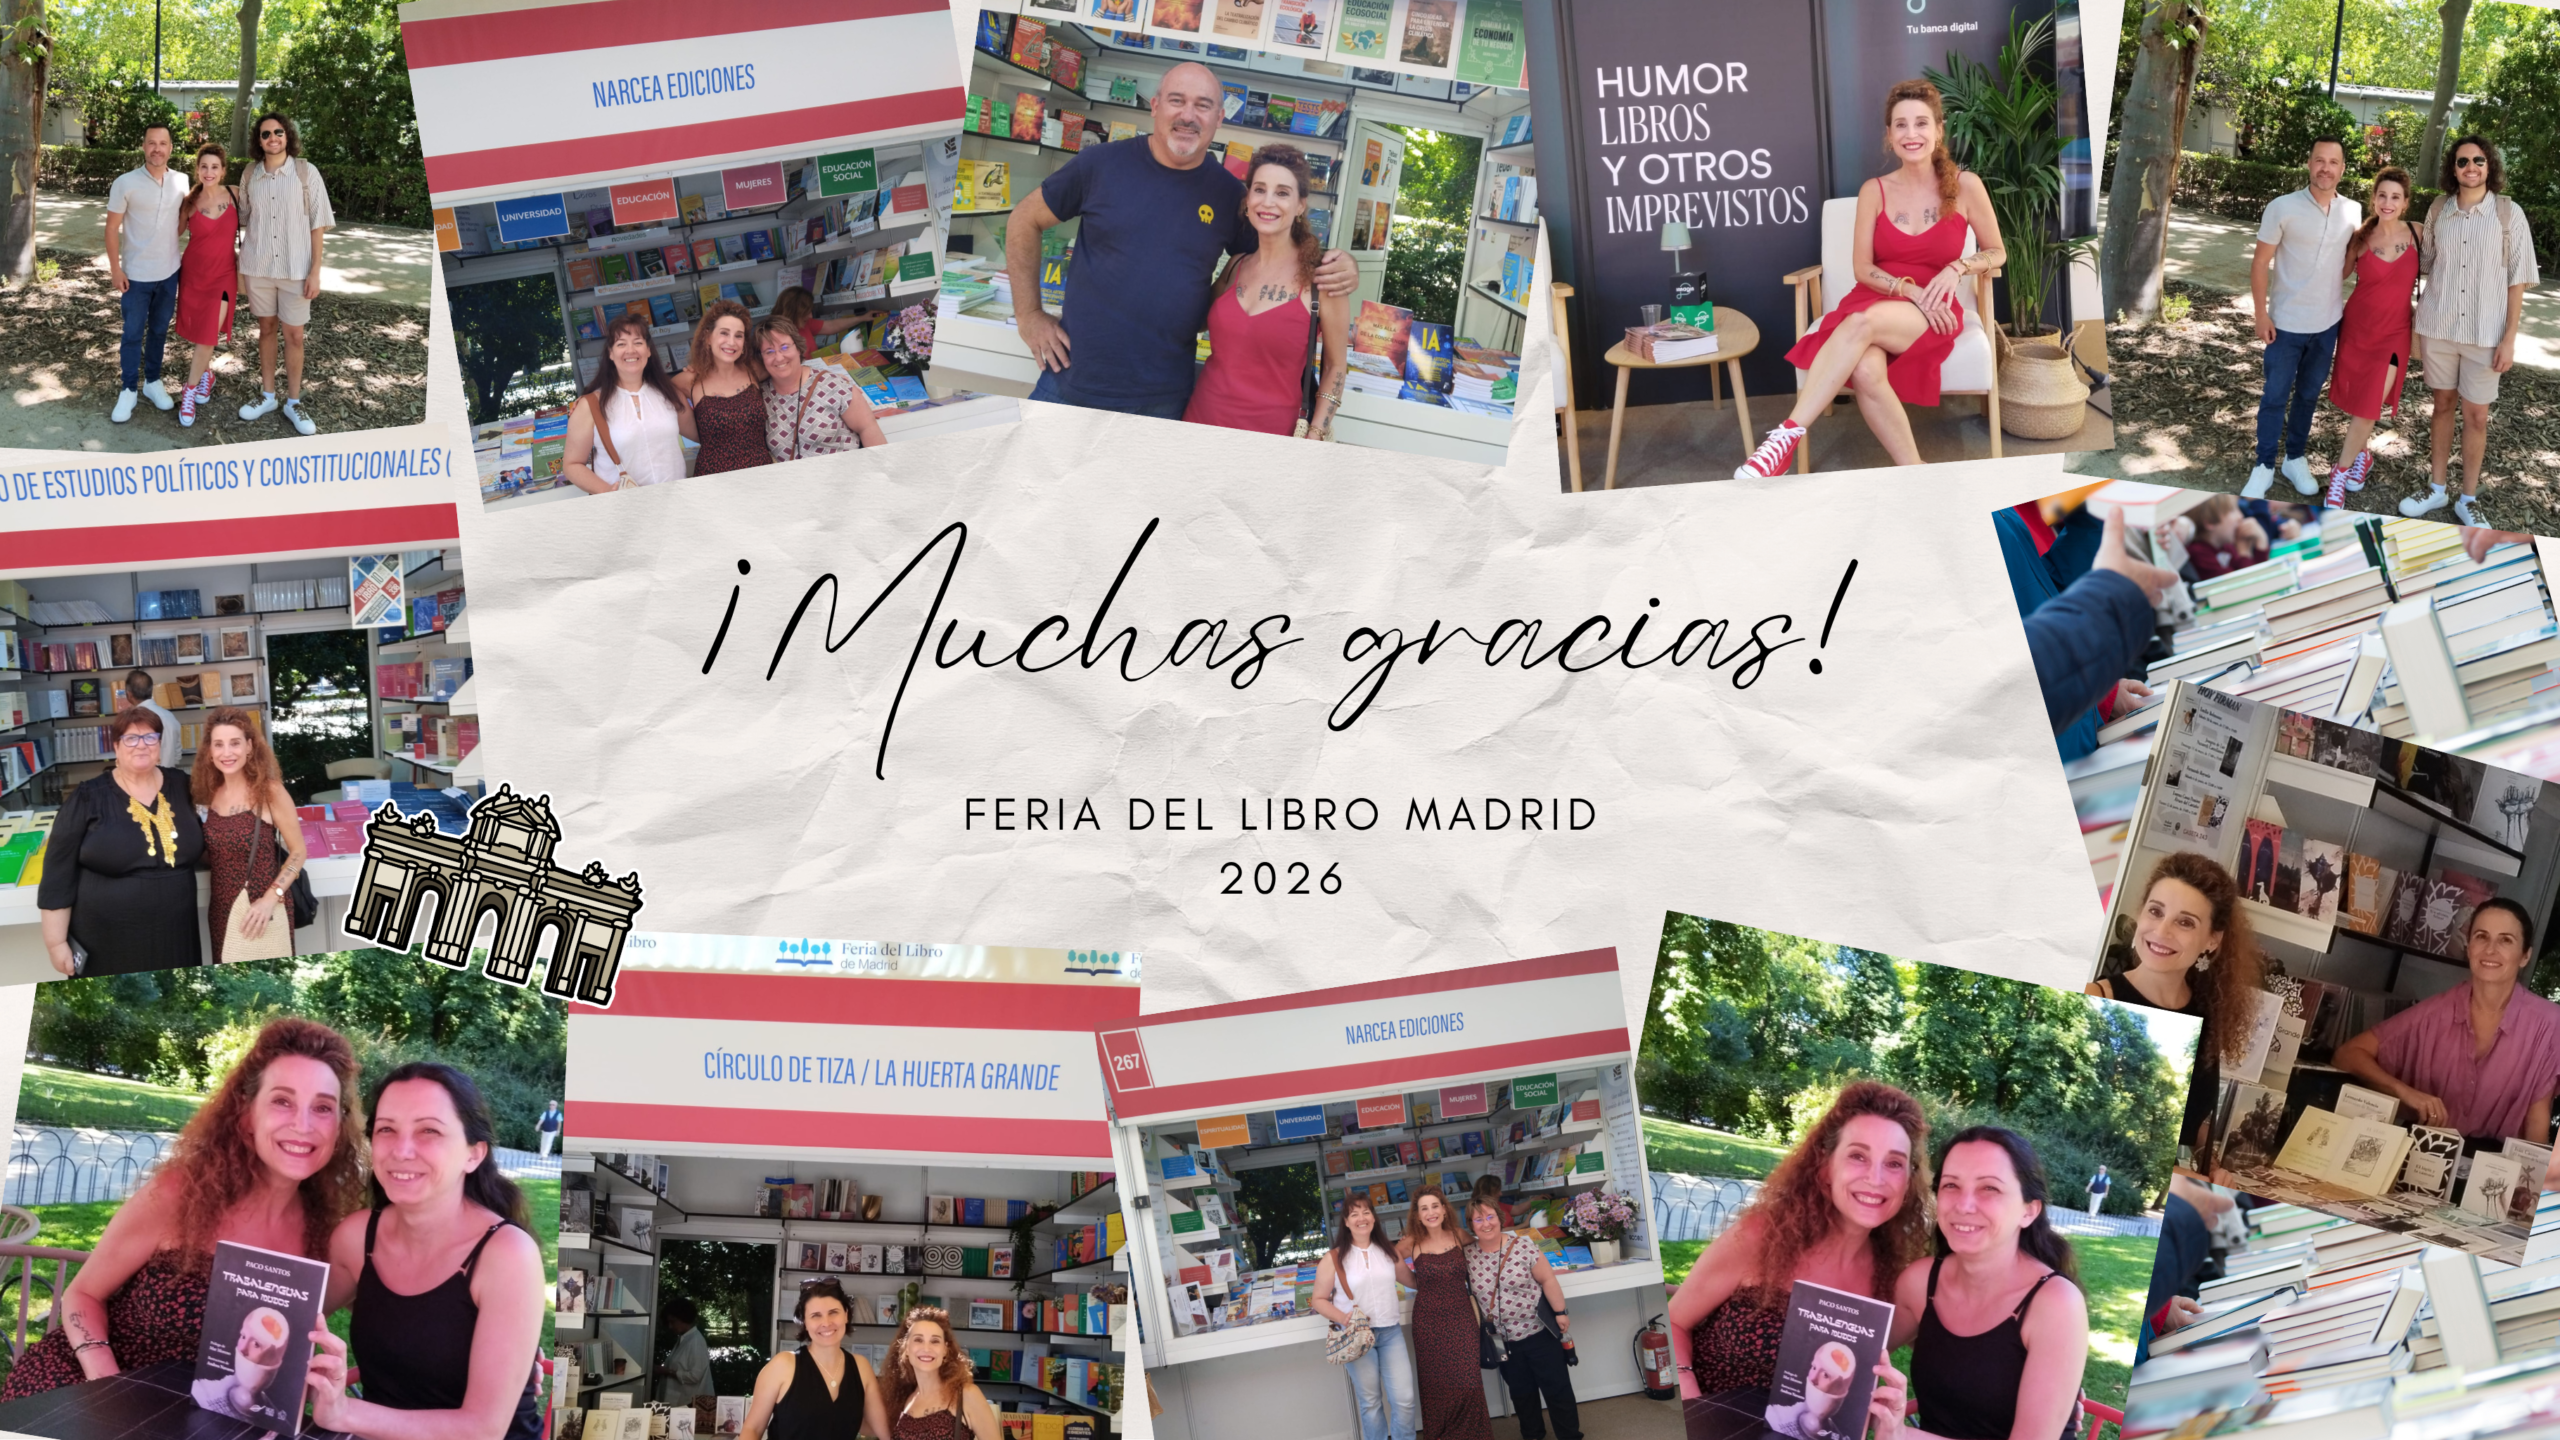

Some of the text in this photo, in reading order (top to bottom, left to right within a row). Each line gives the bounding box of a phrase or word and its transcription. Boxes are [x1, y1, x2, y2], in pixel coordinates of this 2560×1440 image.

[1347, 0, 1390, 11] EDUCACIÓN
[1345, 6, 1388, 20] ECOSOCIAL
[1410, 17, 1450, 28] PARA ENTENDER
[1503, 22, 1510, 30] LA
[1906, 21, 1978, 34] Tu banca digital
[1474, 28, 1514, 42] ECONOMÍA
[1489, 41, 1513, 50] NEGOCIO
[592, 63, 756, 108] NARCEA EDICIONES
[1596, 61, 1749, 99] HUMOR
[1598, 102, 1711, 145] LIBROS
[822, 159, 872, 174] EDUCACIÓN
[1601, 147, 1772, 186] Y OTROS
[735, 177, 772, 190] MUJERES
[833, 171, 863, 182] SOCIAL
[616, 190, 670, 206] EDUCACIÓN
[501, 207, 562, 223] UNIVERSIDAD
[1605, 185, 1809, 234] IMPREVISTOS
[611, 231, 647, 243] novedades
[1043, 262, 1062, 285] IA
[631, 281, 645, 291] hoy
[658, 326, 671, 336] hoy
[1421, 327, 1441, 351] IA
[13, 472, 41, 501] DE
[43, 466, 138, 499] ESTUDIOS
[142, 457, 239, 494] POLÍTICOS
[242, 459, 255, 488] Y
[260, 447, 442, 487] CONSTITUCIONALES
[359, 583, 378, 604] LIBRO
[2197, 685, 2243, 712] HOY FIRMAN
[626, 936, 657, 950] ibro
[841, 942, 943, 958] Feria del Libro
[840, 957, 898, 971] de Madrid
[1131, 953, 1142, 964] F
[1345, 1012, 1464, 1045] NARCEA EDICIONES
[2277, 1025, 2300, 1039] Grande
[704, 1047, 1061, 1092] CÍRCULO DE TIZA / LA HUERTA GRANDE
[1113, 1053, 1140, 1072] 267
[1515, 1081, 1555, 1092] EDUCACIÓN
[1449, 1094, 1477, 1103] MUJERES
[1523, 1090, 1548, 1098] SOCIAL
[1361, 1103, 1400, 1114] EDUCACIÓN
[1279, 1114, 1322, 1125] UNIVERSIDAD
[1199, 1124, 1246, 1135] ESPIRITUALIDAD
[1359, 1131, 1387, 1140] novedades
[245, 1260, 291, 1277] PACO SANTOS
[222, 1271, 310, 1301] TRABALENGUAS
[236, 1287, 290, 1308] PARA MUDOS
[1818, 1299, 1860, 1315] PACO SANTOS
[1797, 1307, 1876, 1338] TRABALENGUAS
[1809, 1323, 1858, 1343] PARA MUDOS
